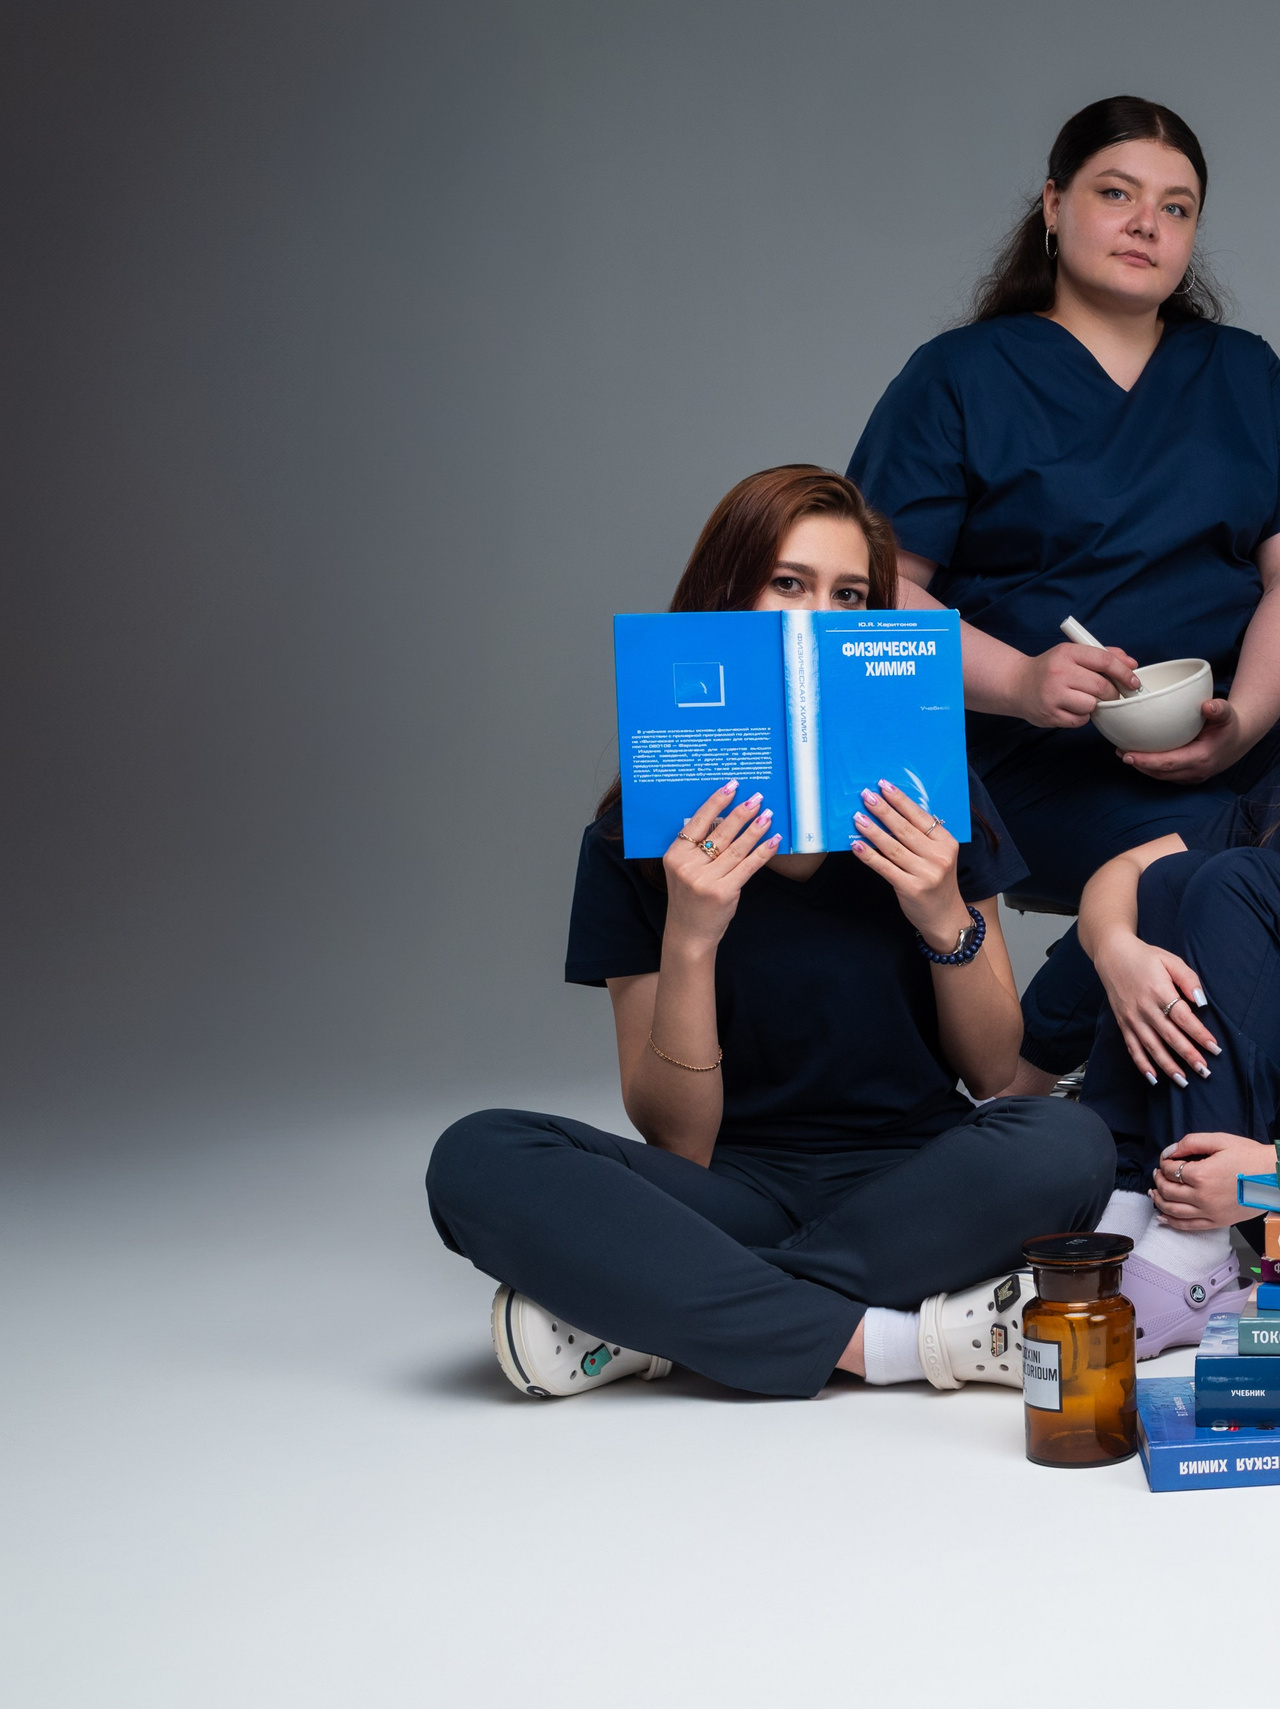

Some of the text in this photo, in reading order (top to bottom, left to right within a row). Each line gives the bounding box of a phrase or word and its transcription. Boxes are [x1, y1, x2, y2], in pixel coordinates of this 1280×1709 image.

[842, 641, 936, 657] ФИЗИЧЕСКАЯ
[866, 661, 916, 676] ХИМИЯ
[797, 632, 808, 743] ФИЗИЧЕСКАЯ ХИМИЯ
[1180, 1459, 1228, 1475] ХИМИЯ
